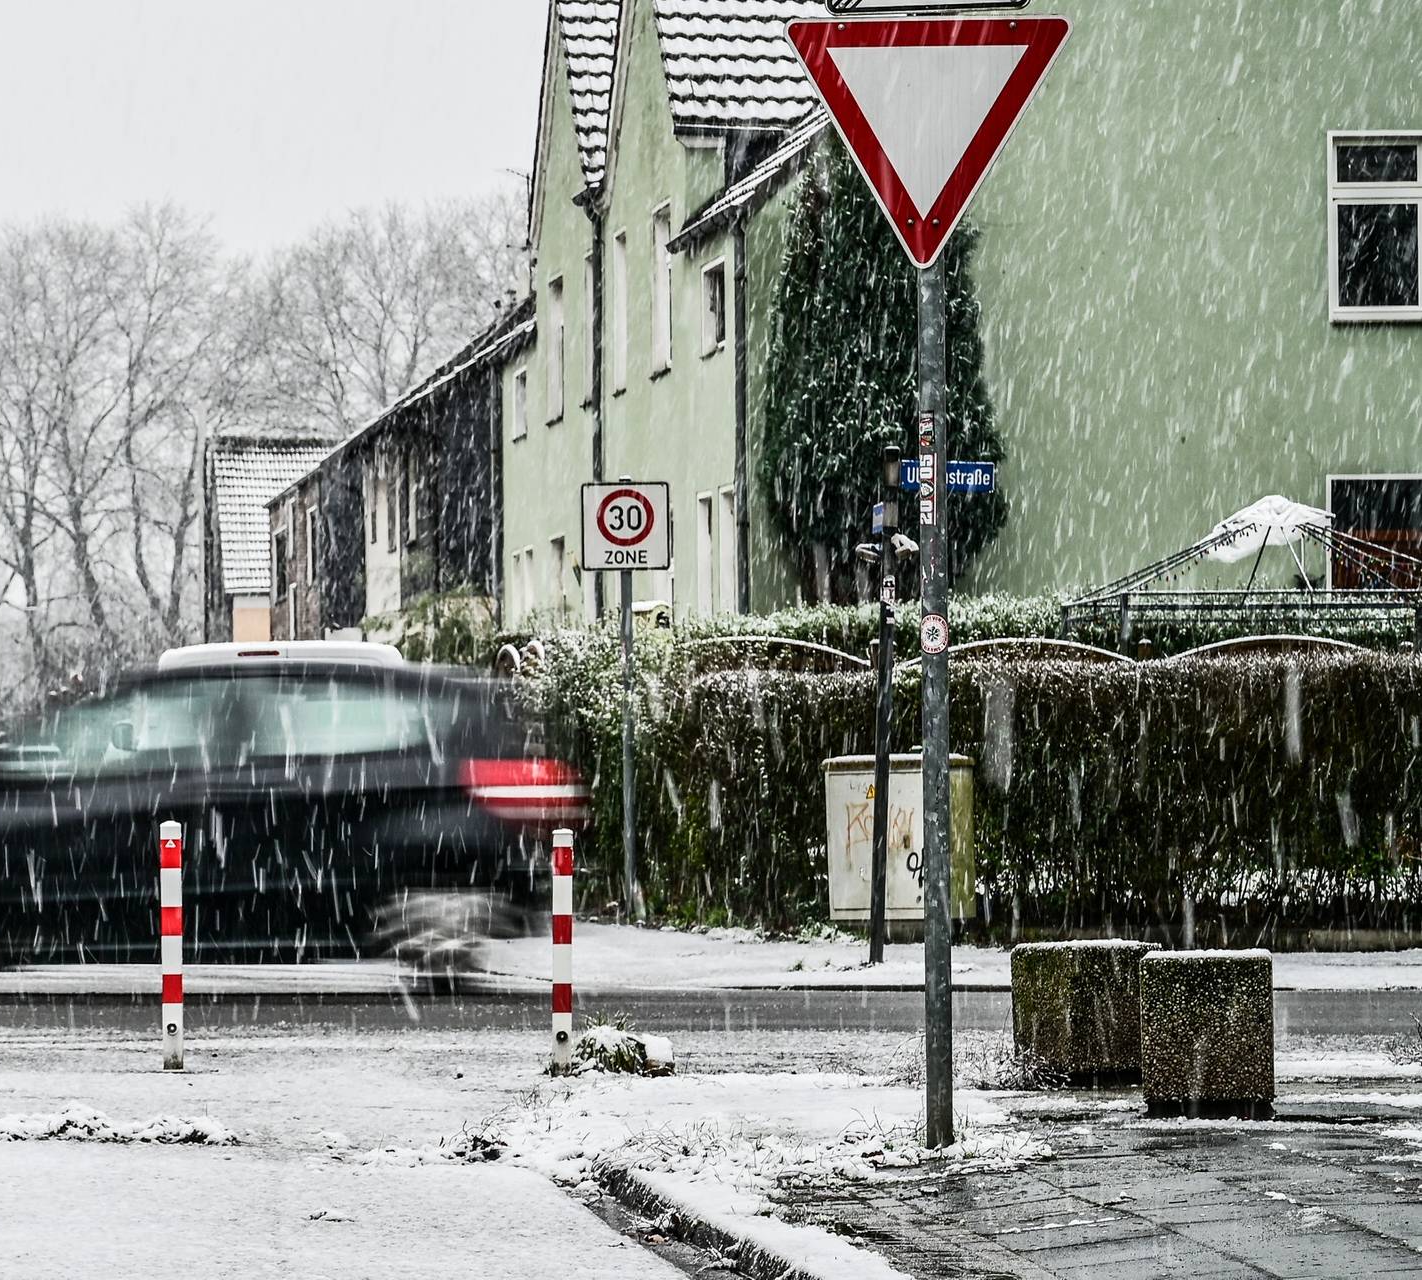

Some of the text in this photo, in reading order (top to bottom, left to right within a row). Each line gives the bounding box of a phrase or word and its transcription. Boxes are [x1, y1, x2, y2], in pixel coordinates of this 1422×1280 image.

[907, 466, 991, 486] Ulstraße
[609, 505, 642, 530] 30
[604, 550, 648, 564] ZONE
